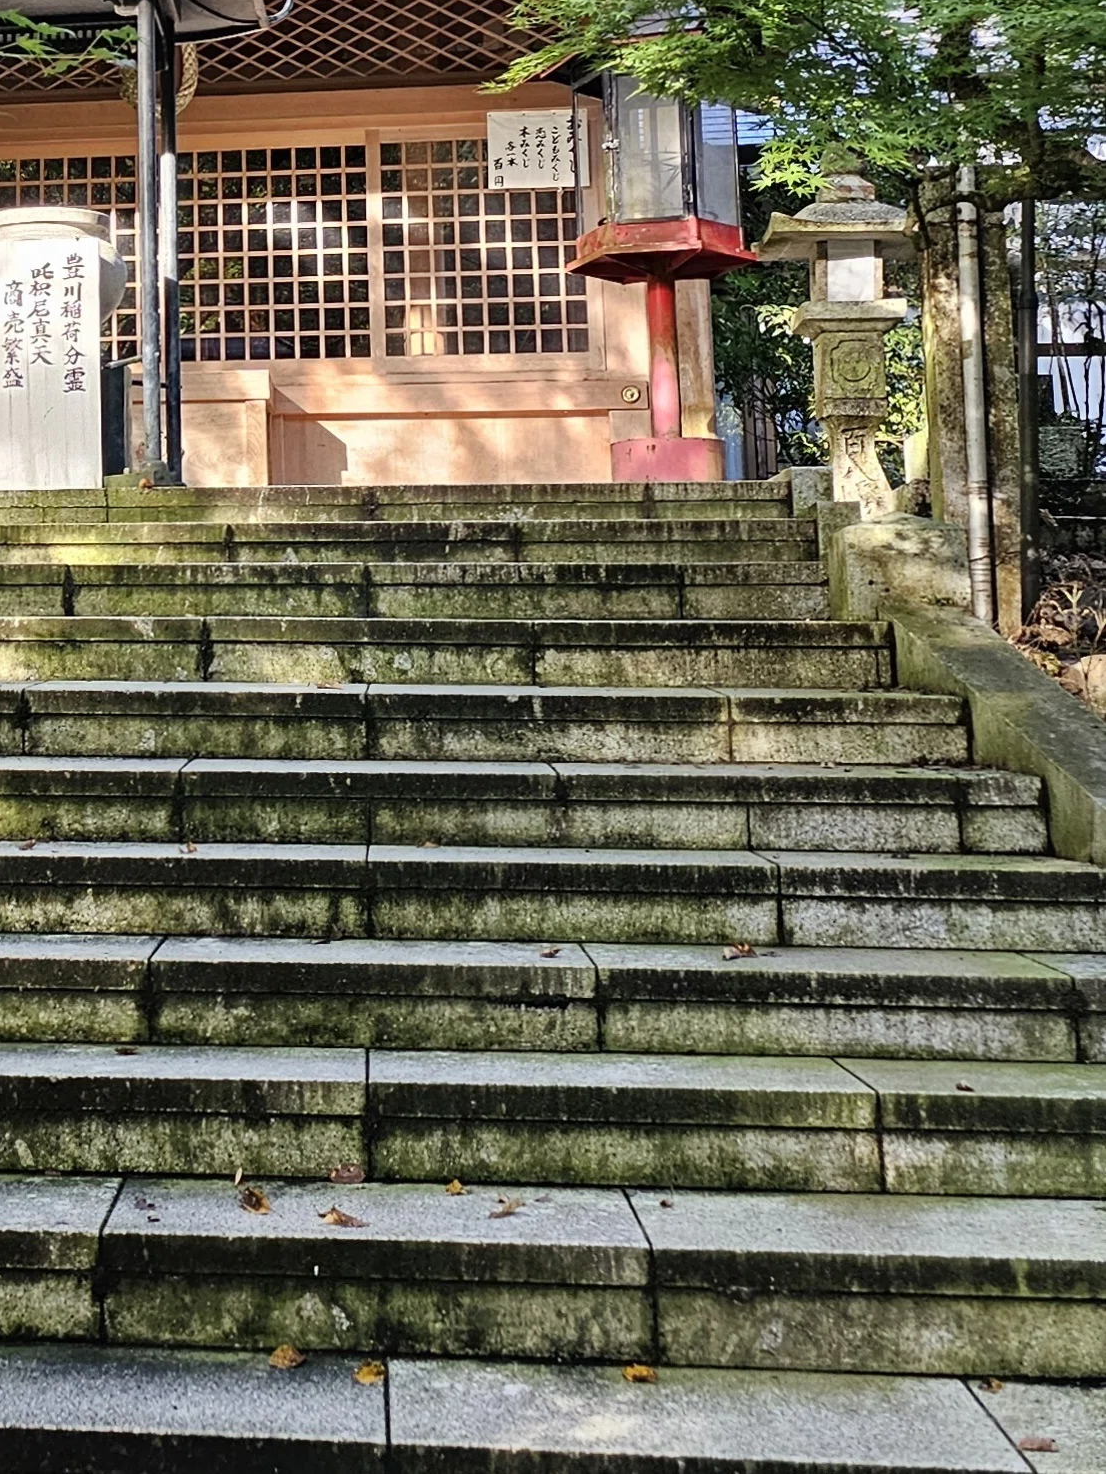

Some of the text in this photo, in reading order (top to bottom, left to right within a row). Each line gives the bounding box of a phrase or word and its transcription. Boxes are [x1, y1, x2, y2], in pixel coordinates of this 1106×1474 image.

[493, 158, 504, 187] 百円
[550, 126, 561, 182] こどもみくじ
[2, 280, 25, 388] 商売繁盛
[60, 253, 87, 393] 豊川稲荷分霊
